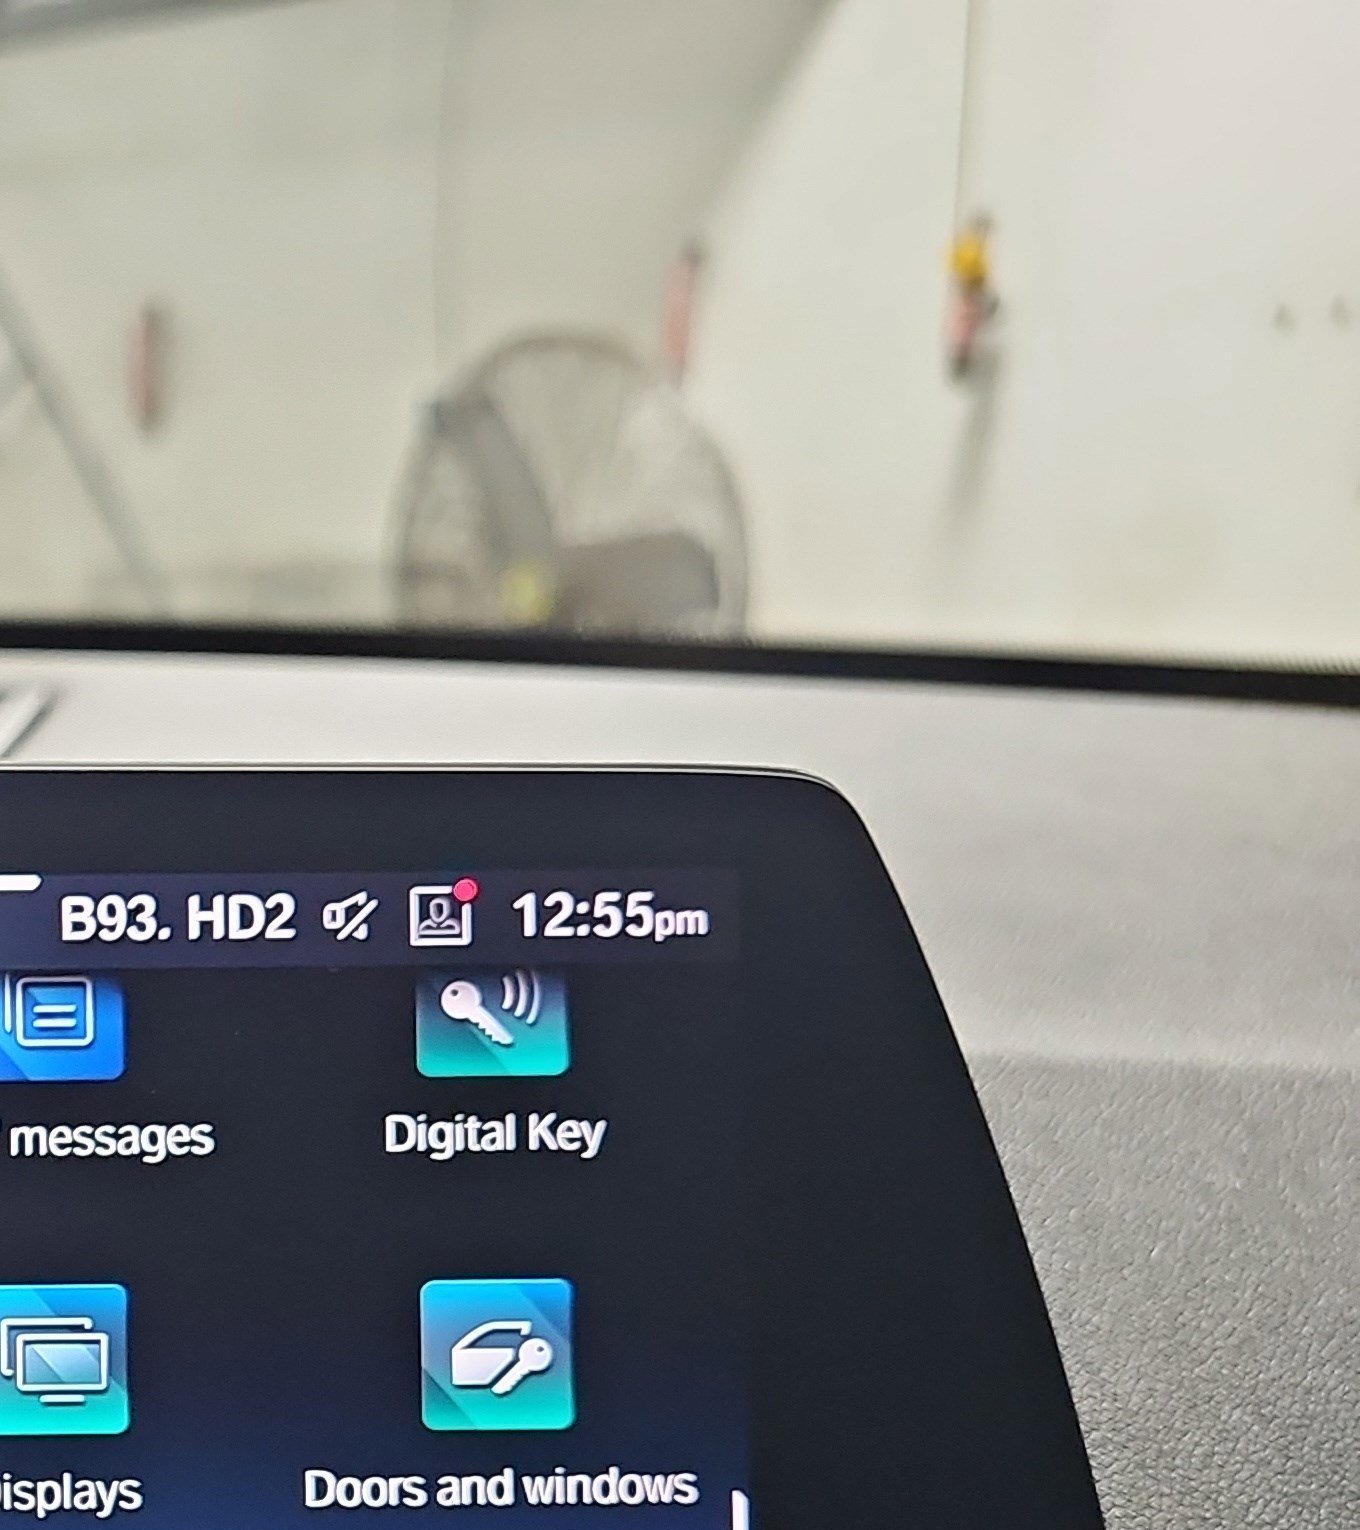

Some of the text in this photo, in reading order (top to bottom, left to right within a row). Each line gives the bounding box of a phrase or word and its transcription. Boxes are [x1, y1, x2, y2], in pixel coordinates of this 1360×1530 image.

[61, 892, 296, 941] B93. HD2
[10, 1123, 215, 1164] messages
[385, 1112, 607, 1161] Digital Key
[304, 1466, 699, 1508] Doors and windows
